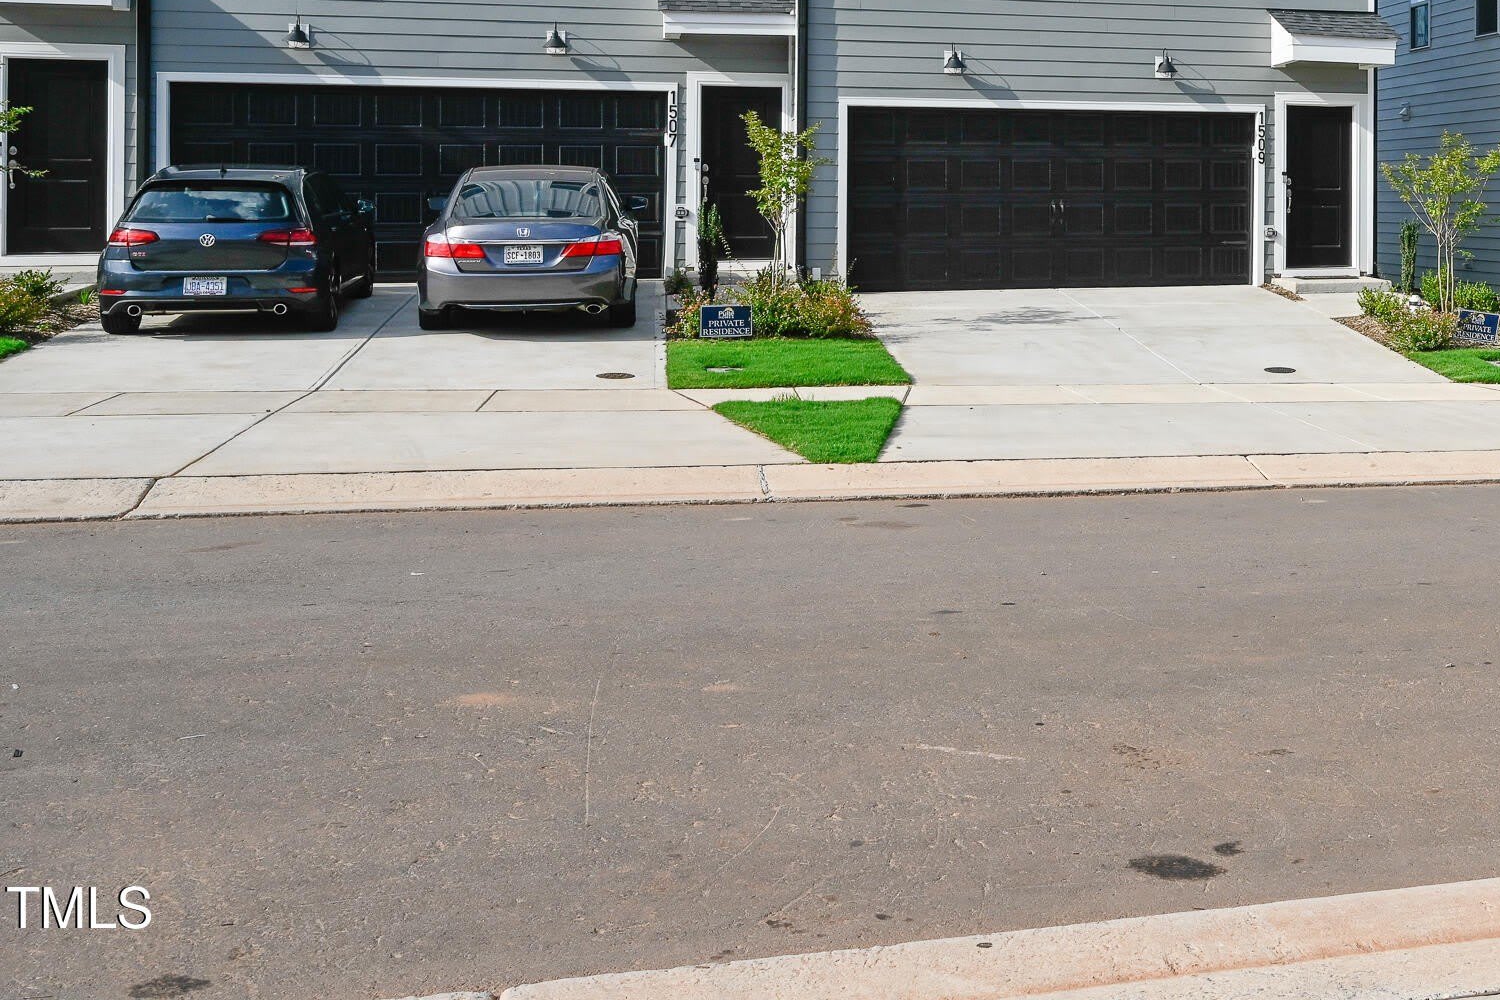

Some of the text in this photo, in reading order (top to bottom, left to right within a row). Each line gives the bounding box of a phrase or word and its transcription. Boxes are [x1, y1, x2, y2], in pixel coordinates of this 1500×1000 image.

[668, 90, 678, 148] 1507
[1258, 111, 1266, 165] 1509
[708, 319, 745, 327] PRIVATE
[1463, 323, 1492, 333] PRIVATE
[702, 327, 750, 336] RESIDENCE
